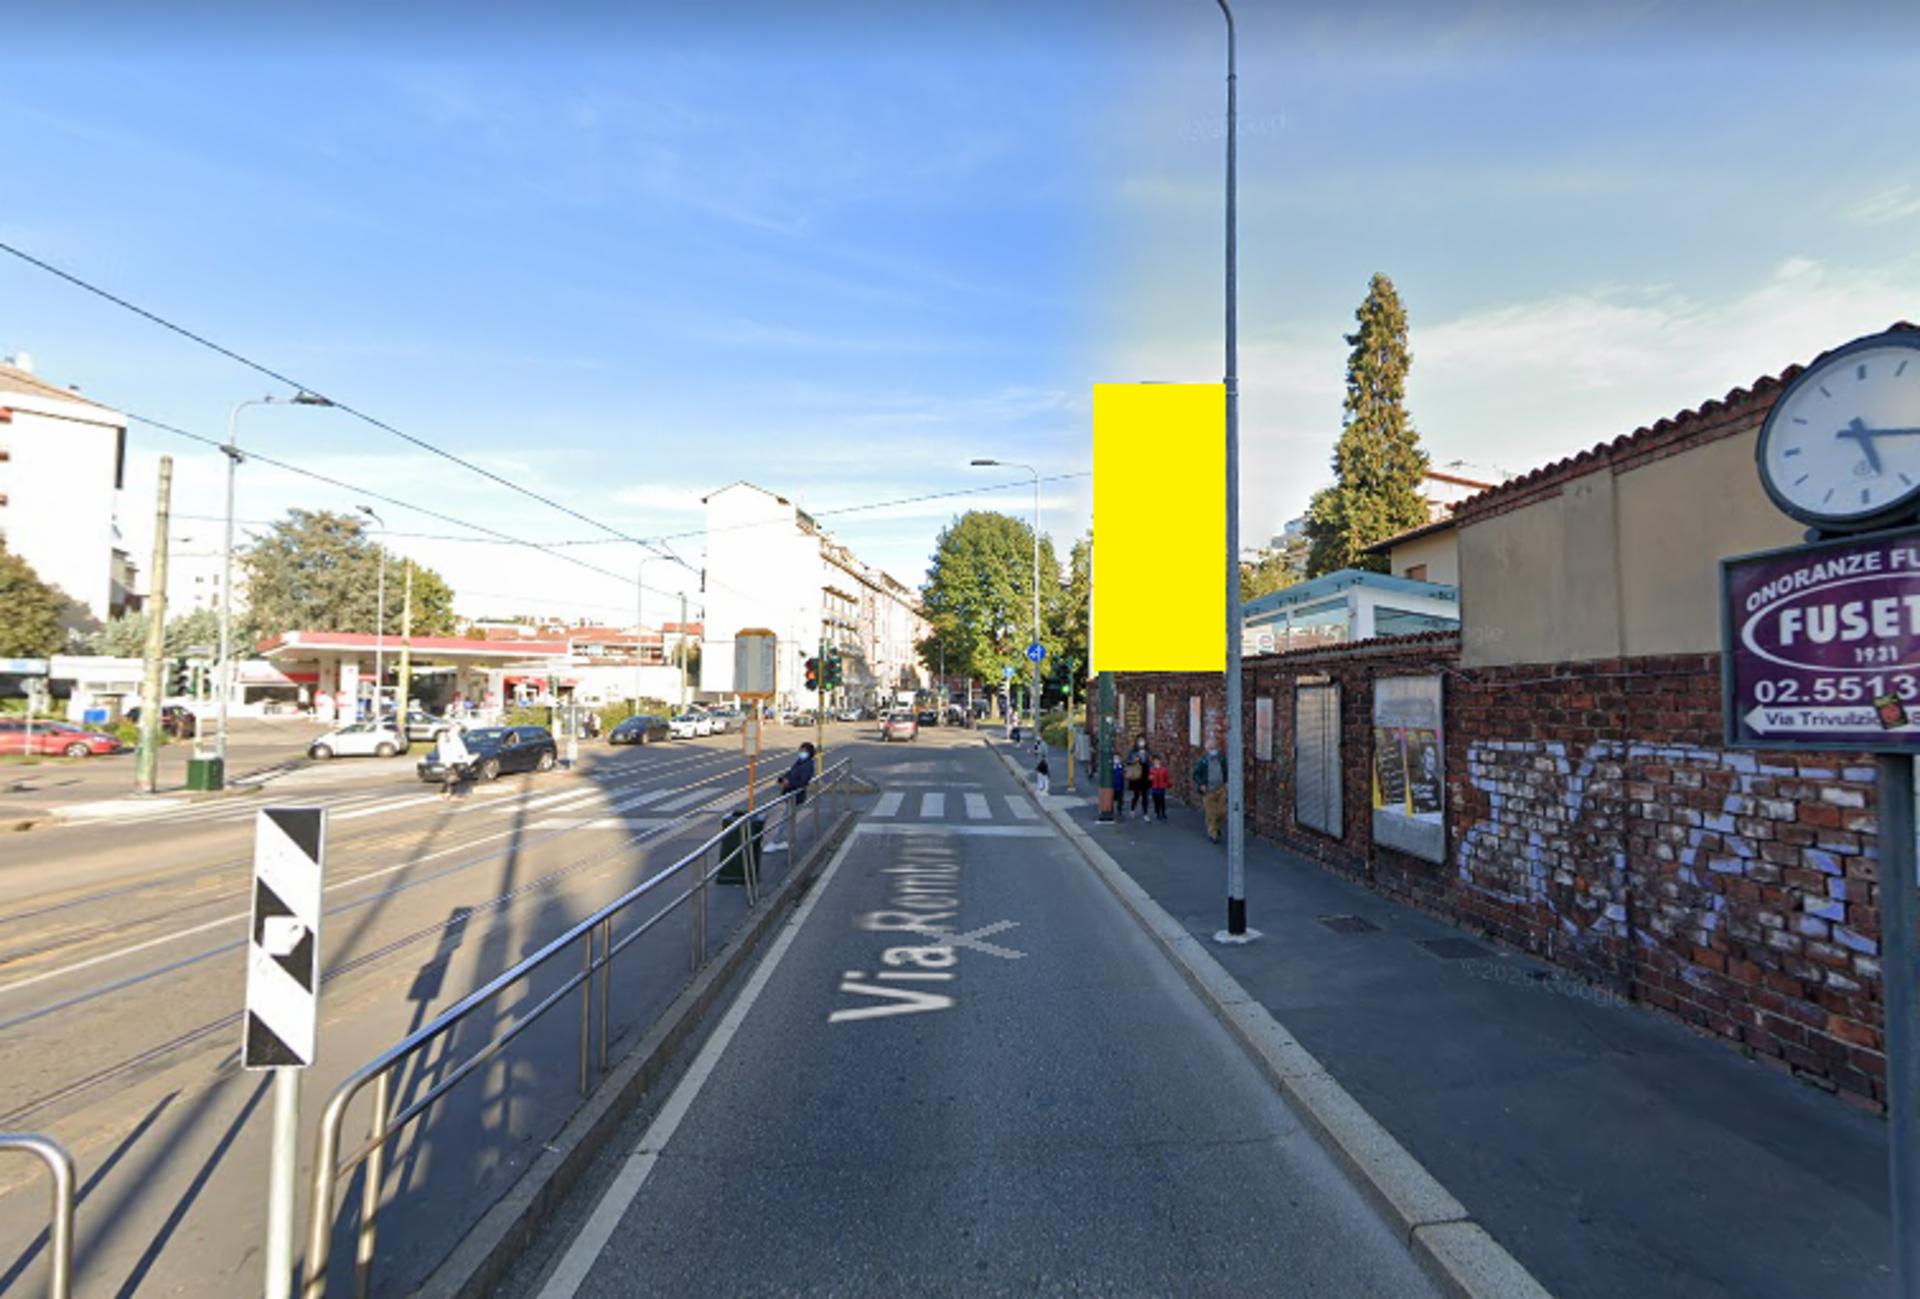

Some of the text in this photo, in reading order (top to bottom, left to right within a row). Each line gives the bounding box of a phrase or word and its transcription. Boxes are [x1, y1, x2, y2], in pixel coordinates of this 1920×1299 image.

[1746, 552, 1881, 611] ONORANZE
[1755, 674, 1918, 702] 02.5513
[1765, 711, 1794, 726] Via
